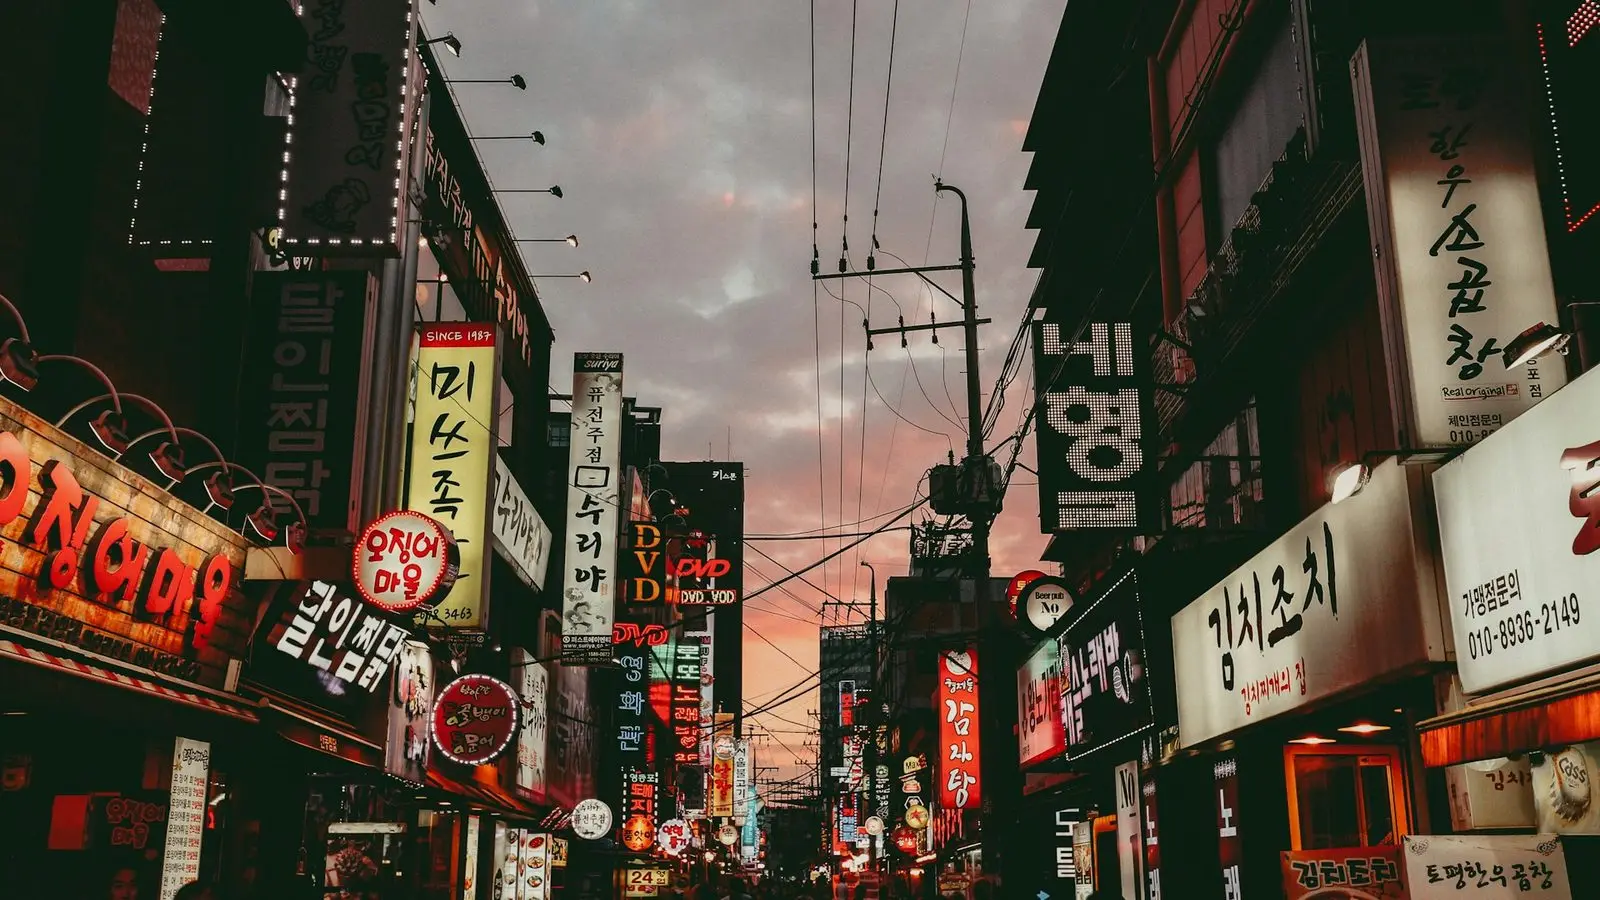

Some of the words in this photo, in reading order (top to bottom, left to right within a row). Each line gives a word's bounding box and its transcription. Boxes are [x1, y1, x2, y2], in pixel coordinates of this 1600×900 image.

[426, 329, 463, 342] SINCE
[467, 329, 492, 342] 1987
[584, 358, 620, 371] suriya
[1442, 387, 1464, 397] Real
[585, 387, 605, 463] 퓨전주점
[367, 528, 439, 564] 오징어
[574, 494, 606, 592] 수리야
[633, 524, 661, 601] DVD
[677, 559, 731, 577] DVD
[374, 564, 422, 600] 마을
[1035, 592, 1050, 600] Beer
[1462, 569, 1522, 619] 가맹점문의
[445, 608, 472, 619] 3463
[1041, 601, 1059, 614] No
[1208, 521, 1338, 690] 김치조치
[613, 623, 669, 648] DVD
[1468, 592, 1580, 659] 010-8936-2149
[1241, 667, 1291, 715] 김치찌개의
[1295, 656, 1306, 695] 집
[631, 871, 653, 883] 24
